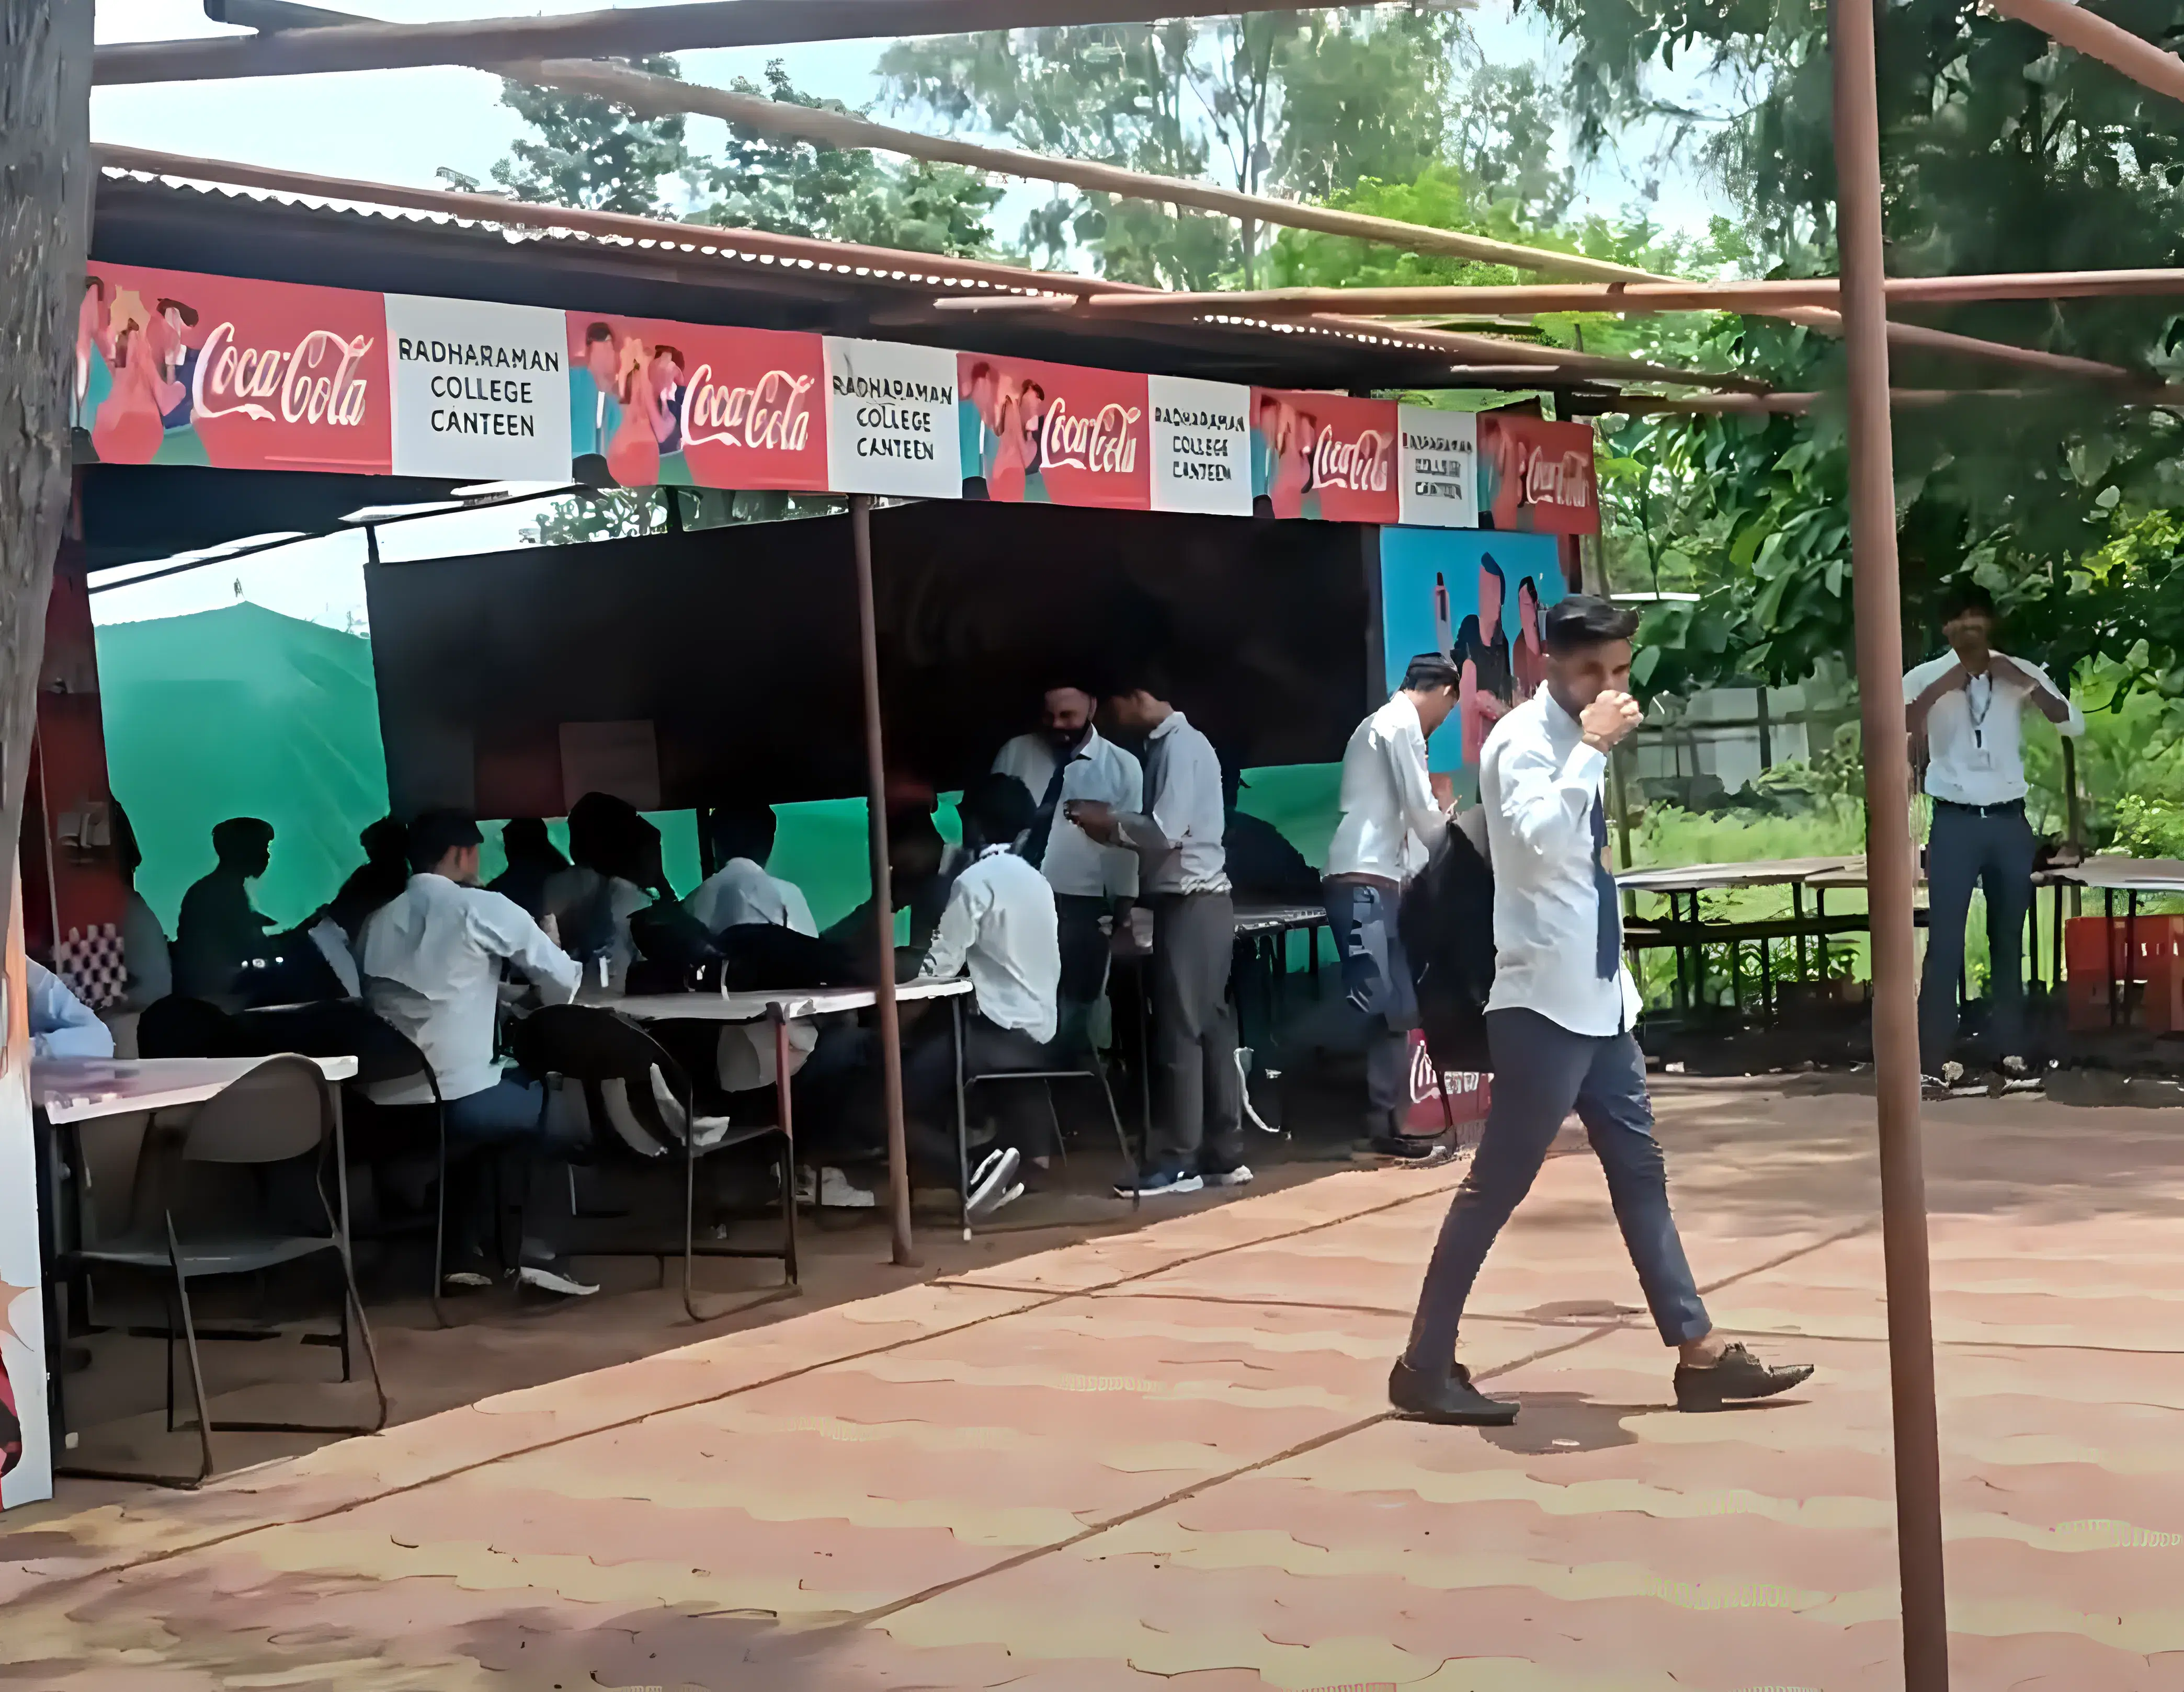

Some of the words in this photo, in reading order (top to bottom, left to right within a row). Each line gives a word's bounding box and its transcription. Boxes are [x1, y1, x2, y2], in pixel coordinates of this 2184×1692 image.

[398, 337, 560, 373] RADHARAMAN
[191, 322, 374, 426] Coca-Cola
[430, 375, 533, 403] COLLEGE
[681, 363, 815, 452] Coca-Cola
[856, 405, 931, 432] COLLEGE
[430, 409, 534, 437] CANTEEN
[857, 437, 934, 460] CANTEEN
